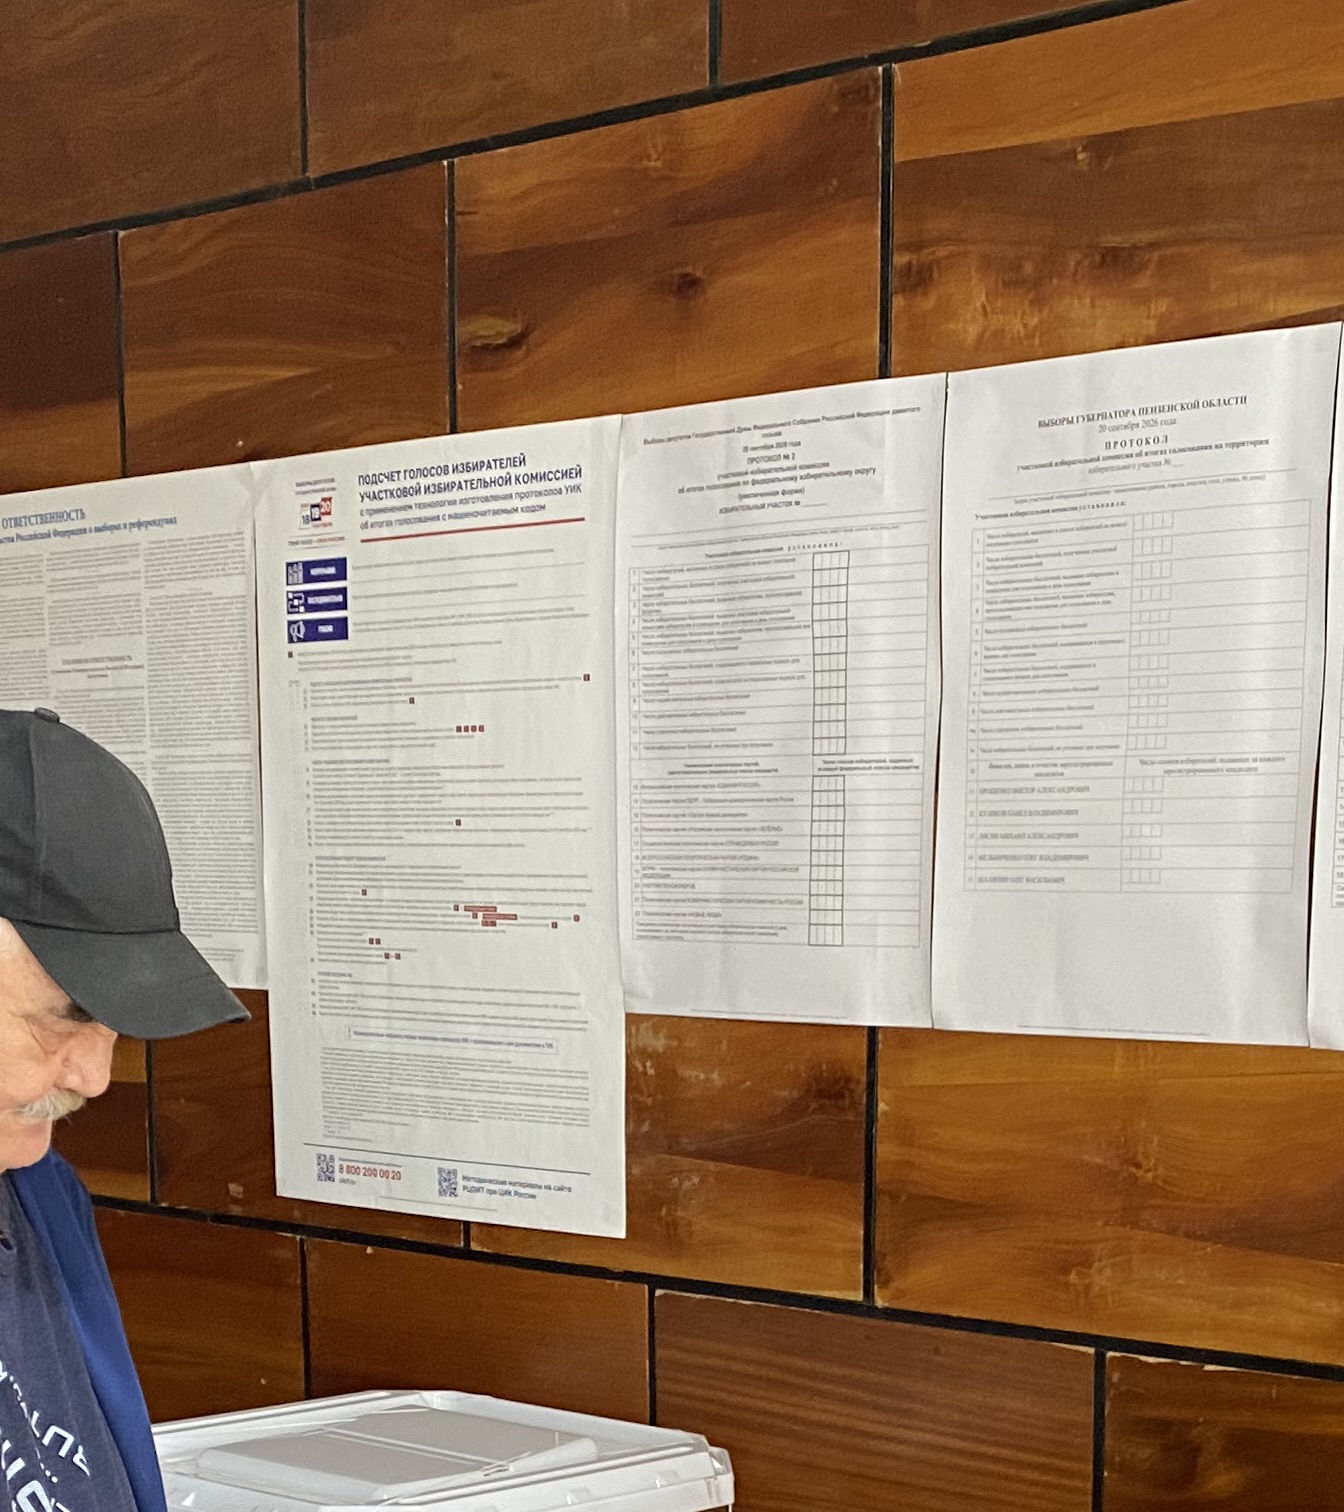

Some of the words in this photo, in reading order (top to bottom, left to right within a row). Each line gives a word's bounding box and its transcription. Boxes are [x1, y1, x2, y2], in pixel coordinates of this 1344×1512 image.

[1038, 416, 1074, 428] ВЫБОРЫ
[1076, 409, 1136, 424] ГУБЕРНАТОРА
[1138, 399, 1200, 416] ПЕНЗЕНСКОЙ
[1202, 395, 1247, 408] ОБЛАСТИ
[358, 470, 402, 486] ПОДСЧЕТ
[403, 464, 450, 480] ГОЛОСОВ
[452, 452, 526, 474] ИЗБИРАТЕЛЕЙ
[359, 482, 421, 503] УЧАСТКОВОЙ
[424, 472, 512, 495] ИЗБИРАТЕЛЬНОЙ
[514, 464, 582, 485] КОМИССИЕЙ
[564, 484, 582, 495] УИК
[1, 508, 86, 529] ОТВЕТСТВЕННОСТЬ
[391, 1170, 401, 1181] 20
